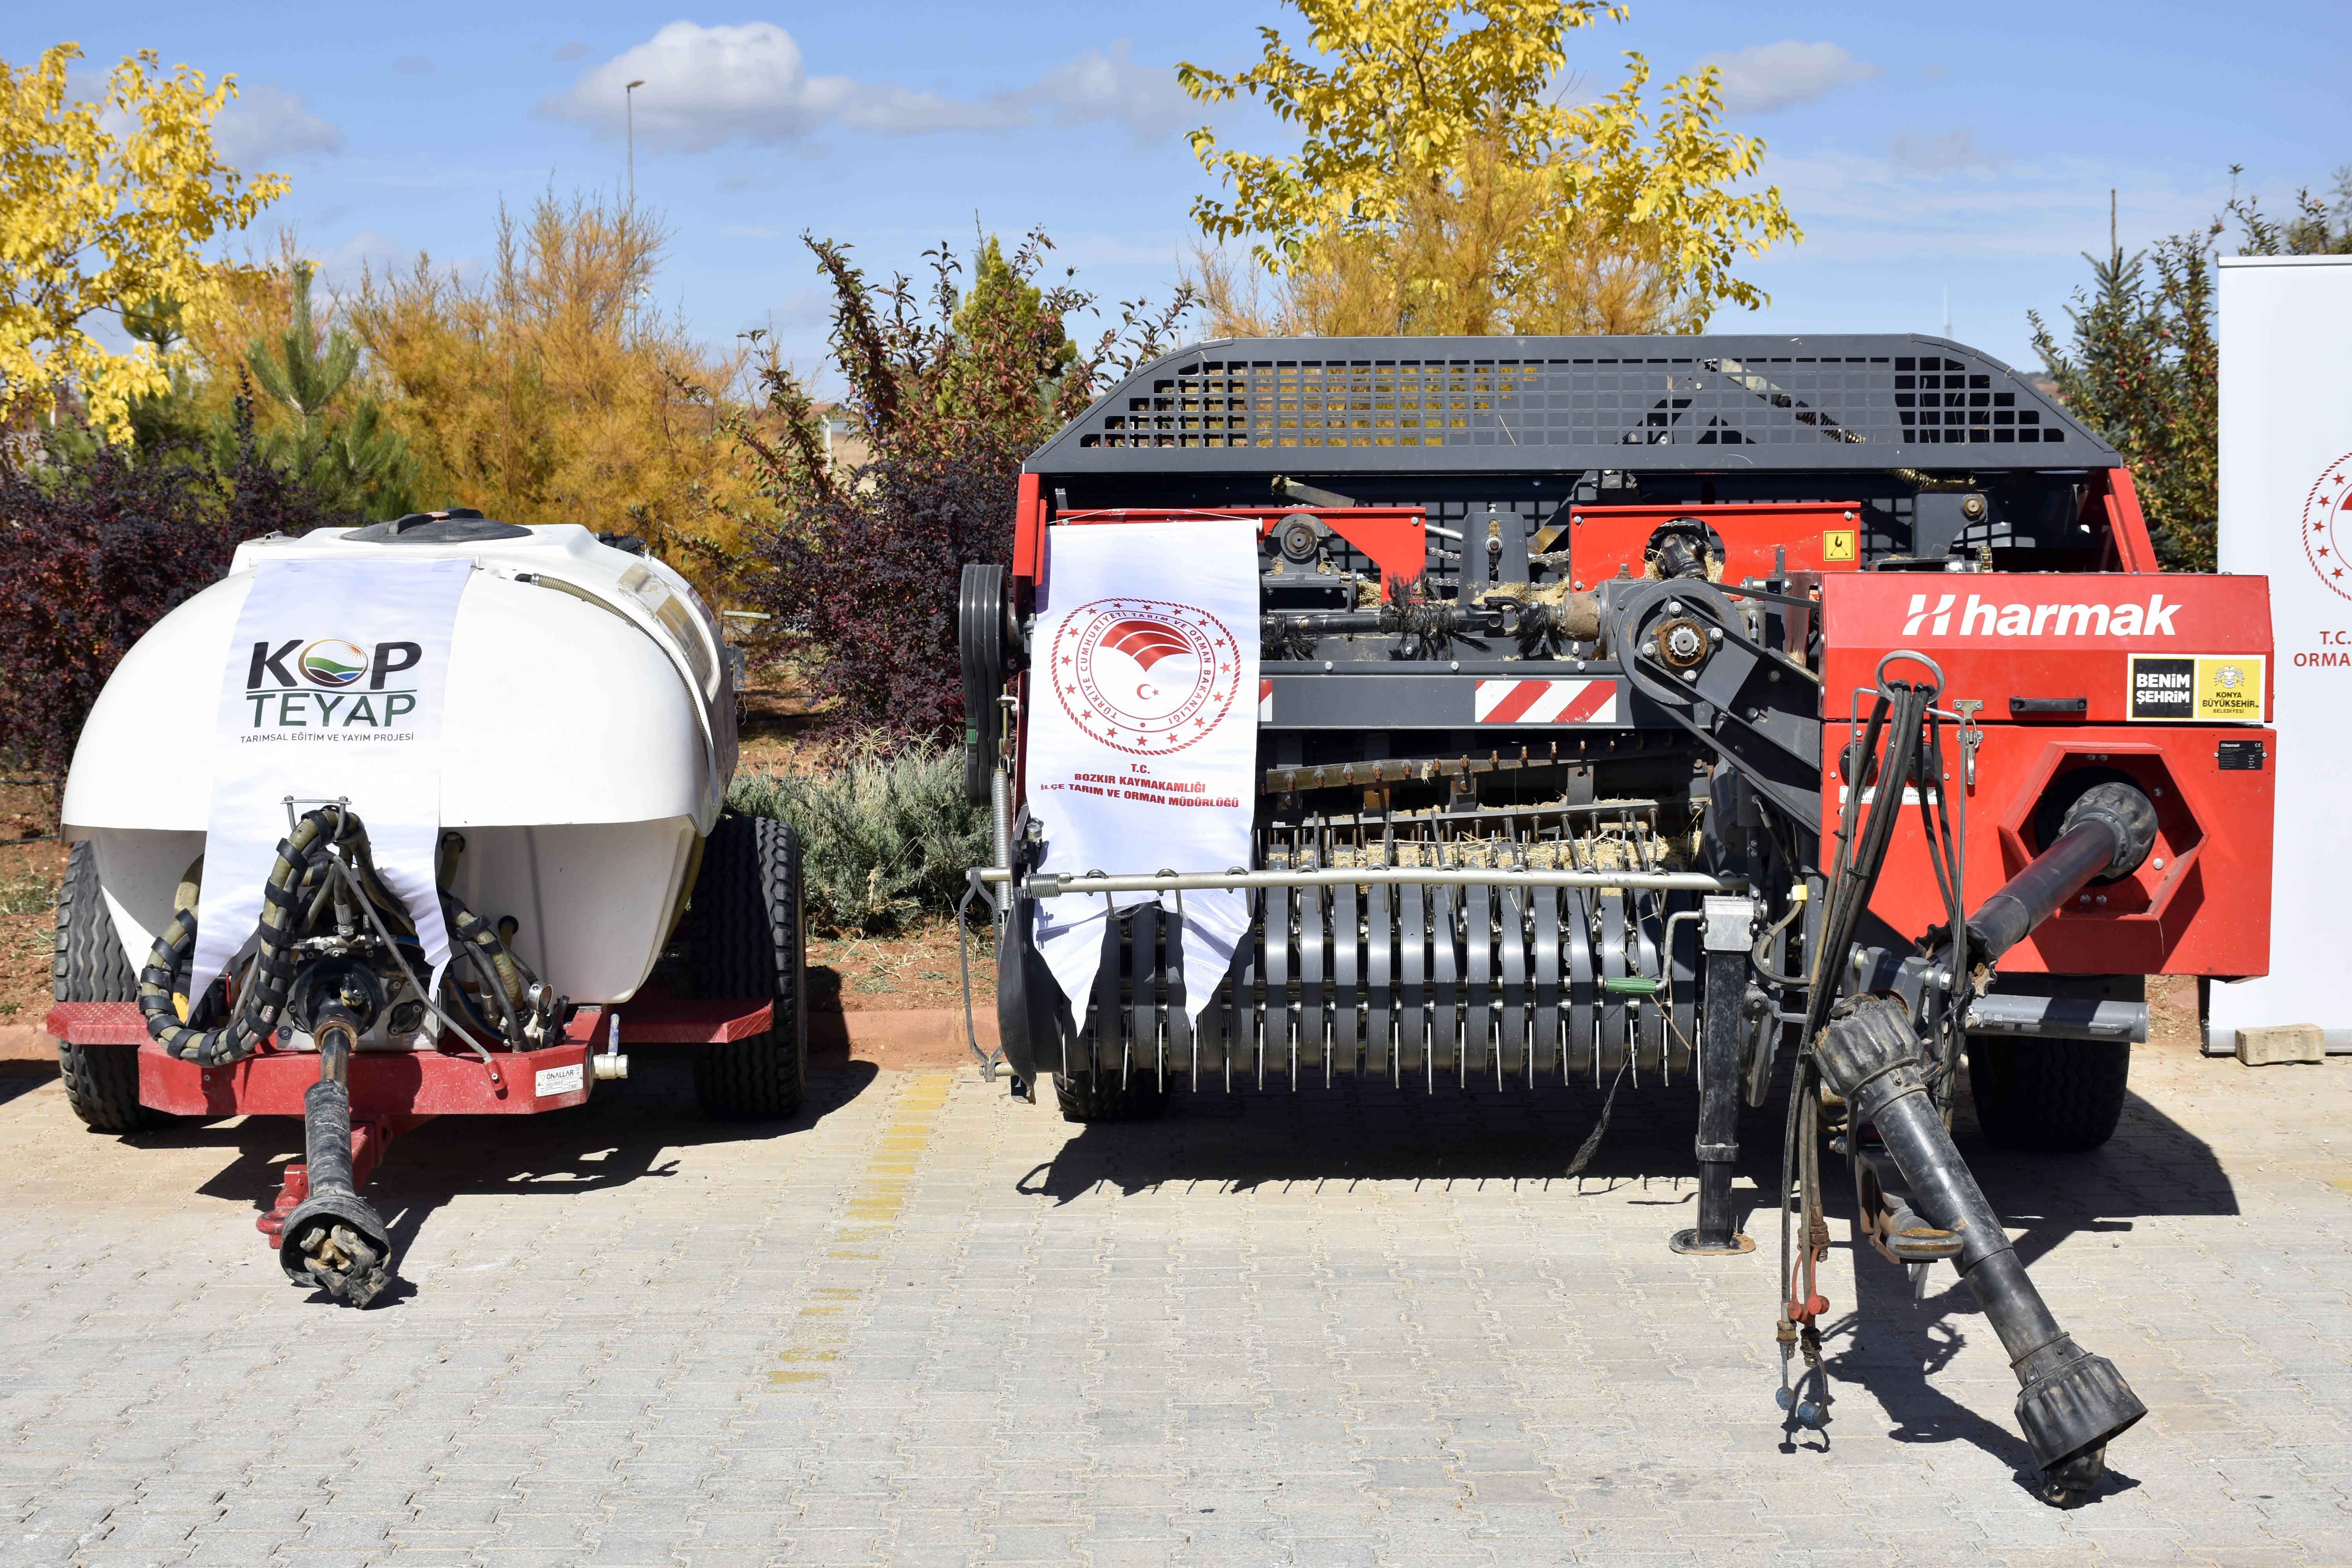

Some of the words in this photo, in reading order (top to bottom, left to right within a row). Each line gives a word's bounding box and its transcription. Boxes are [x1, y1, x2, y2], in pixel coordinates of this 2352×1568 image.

[1131, 612, 1168, 621] TARIM
[1959, 594, 2183, 636] harmak
[1174, 620, 1187, 629] VE
[1080, 612, 1127, 671] CUMHURİYETİ
[2321, 631, 2351, 644] T.C.
[1189, 630, 1211, 663] ORMAN
[247, 639, 423, 690] KOP
[2294, 653, 2351, 667] ORMA
[2136, 673, 2190, 688] BENİM
[1083, 677, 1117, 719] TÜRKİYE
[1169, 669, 1211, 724] BAKANLIĞI
[2136, 690, 2190, 705] ŞEHRİM
[2202, 698, 2255, 708] BÜYÜKŞEHİR
[246, 693, 416, 728] TEYAP
[240, 733, 289, 744] TARIMSAL
[291, 731, 325, 741] EĞİTİM
[374, 731, 414, 741] PROJESİ
[1131, 763, 1150, 774] T.C.
[1074, 773, 1116, 784] BOZKIR
[1119, 776, 1206, 793] KAYMAKAMLIĞI
[1069, 784, 1103, 795] TARIM
[1107, 789, 1120, 798] VE
[1124, 790, 1165, 804] ORMAN
[1169, 797, 1240, 808] MÜDÜRLÜĞÜ
[546, 1069, 574, 1080] ÖNALLAR
